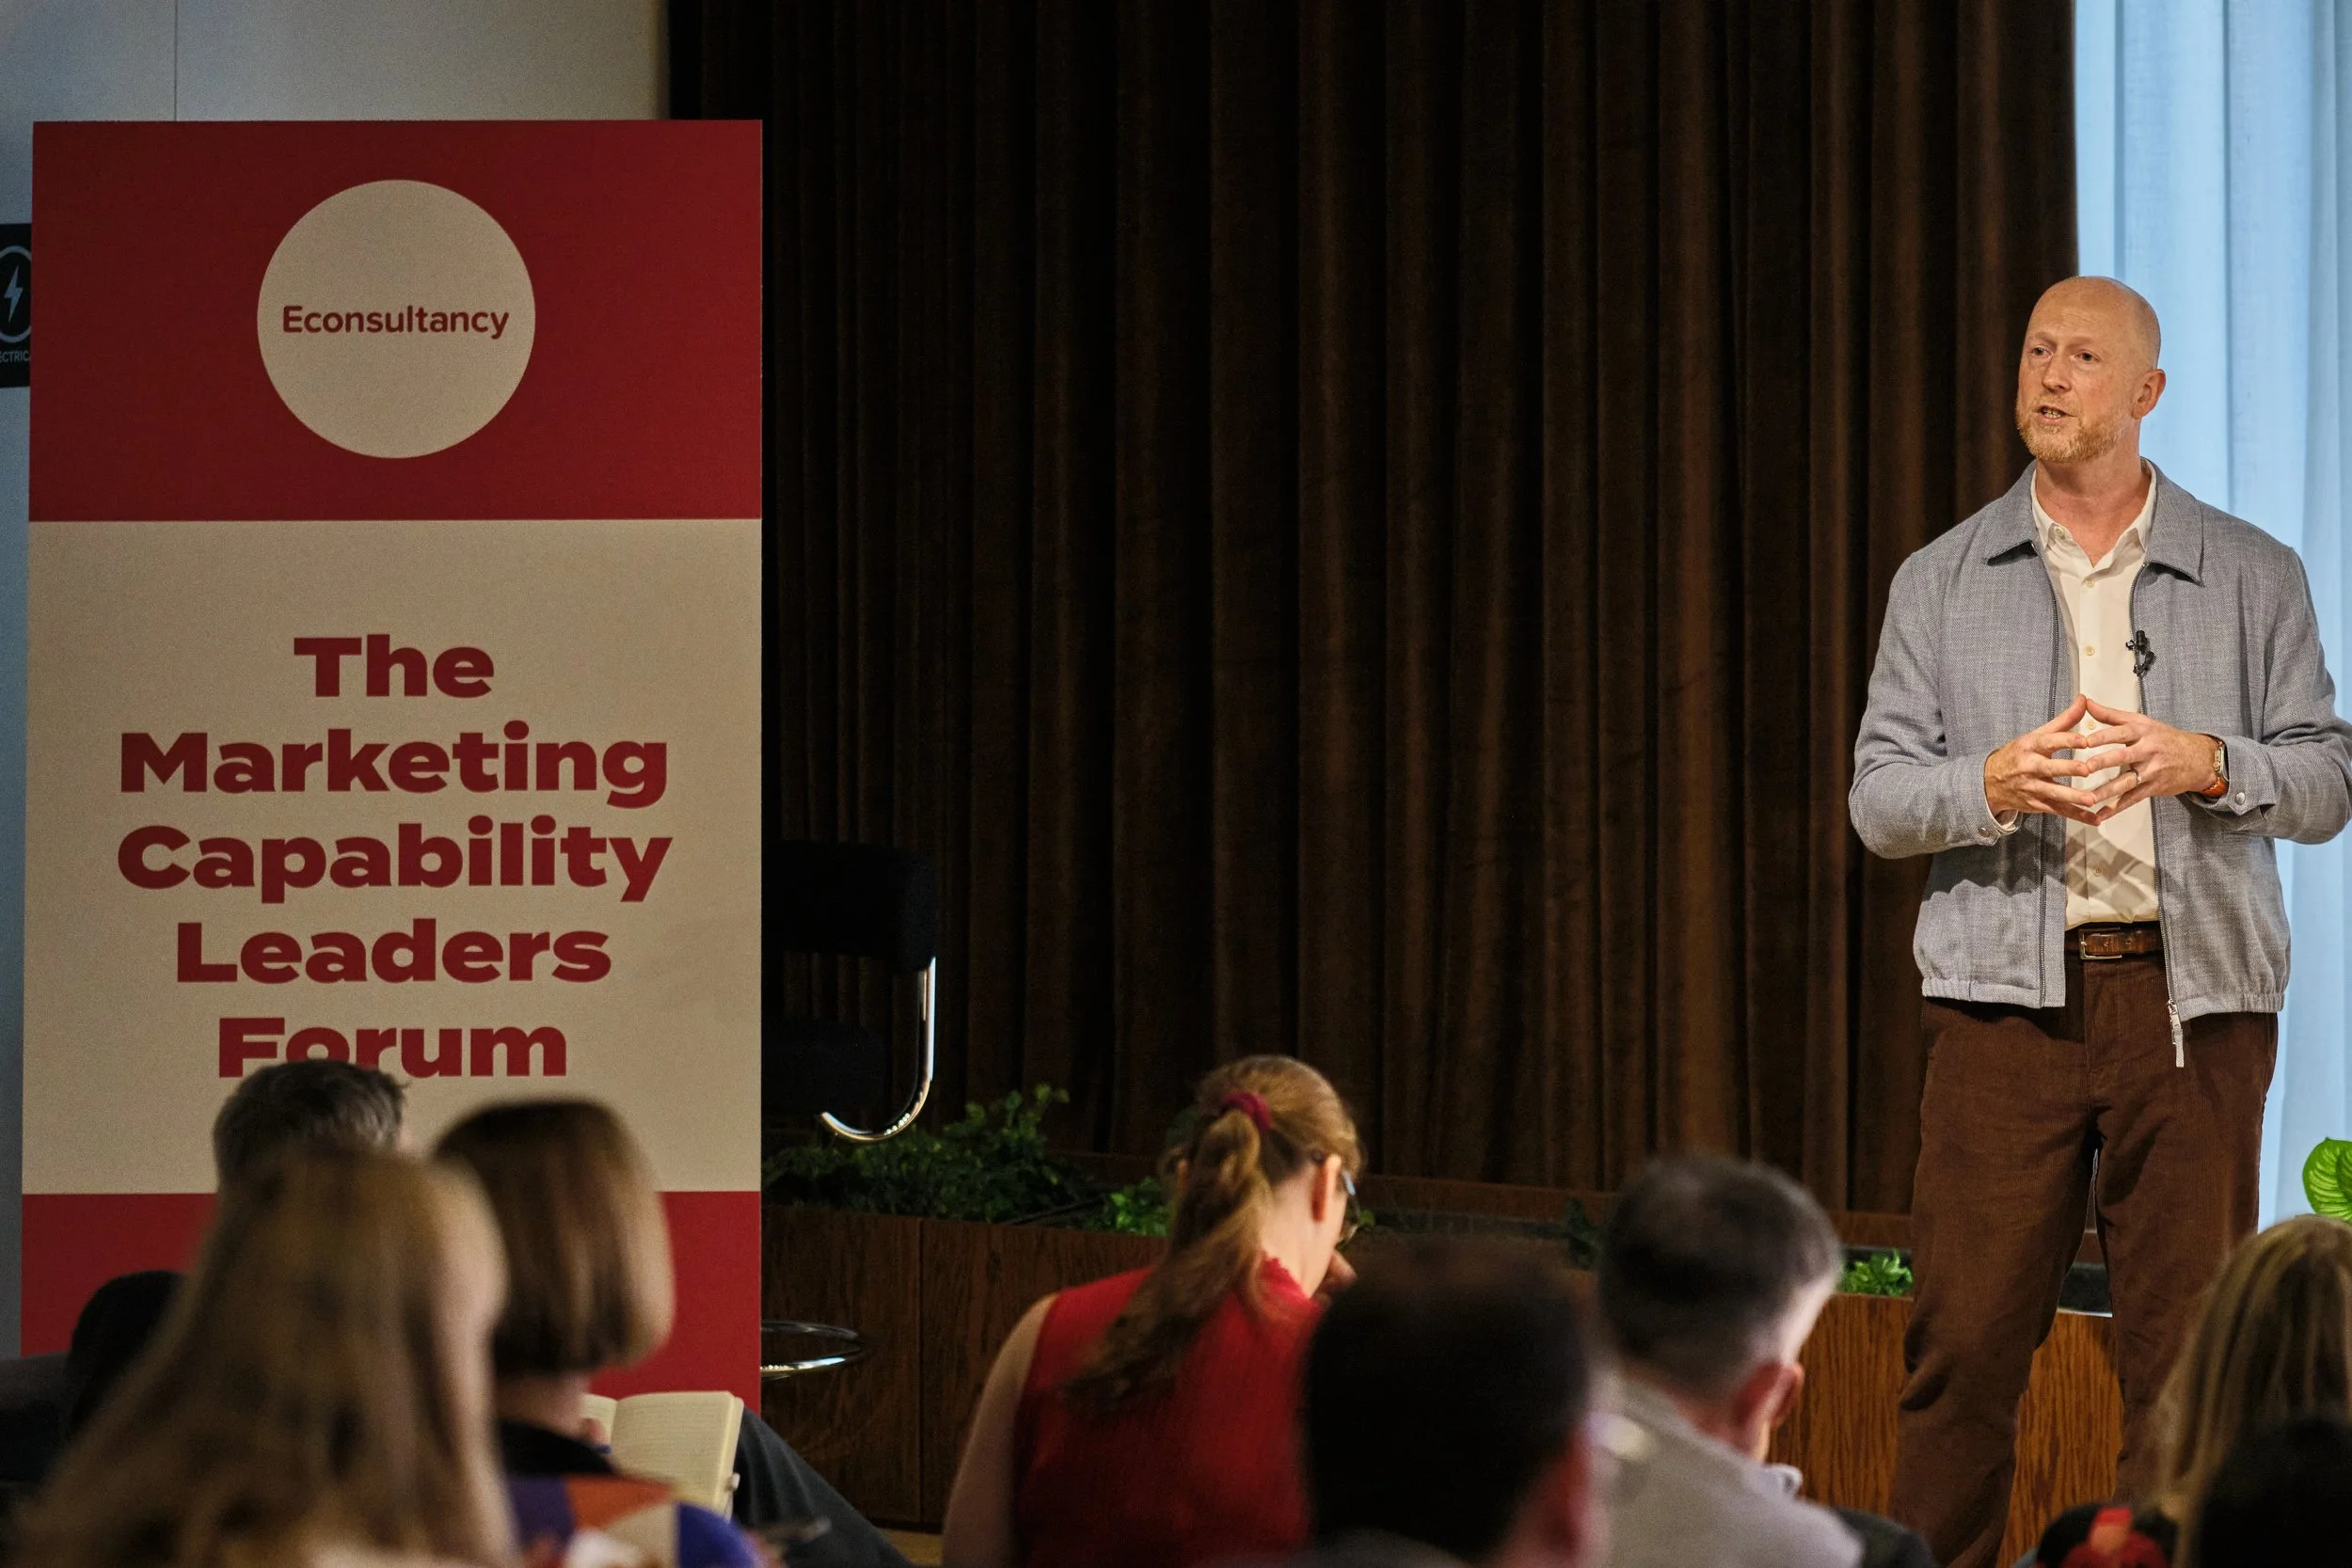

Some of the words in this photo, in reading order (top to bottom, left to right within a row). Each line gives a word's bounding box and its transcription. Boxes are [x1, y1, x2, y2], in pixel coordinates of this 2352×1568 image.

[282, 305, 510, 340] Econsultancy
[294, 634, 494, 698] The
[121, 721, 667, 808] Marketing
[119, 815, 672, 904] Capability
[178, 918, 612, 984] Leaders
[219, 1017, 567, 1079] Forum
